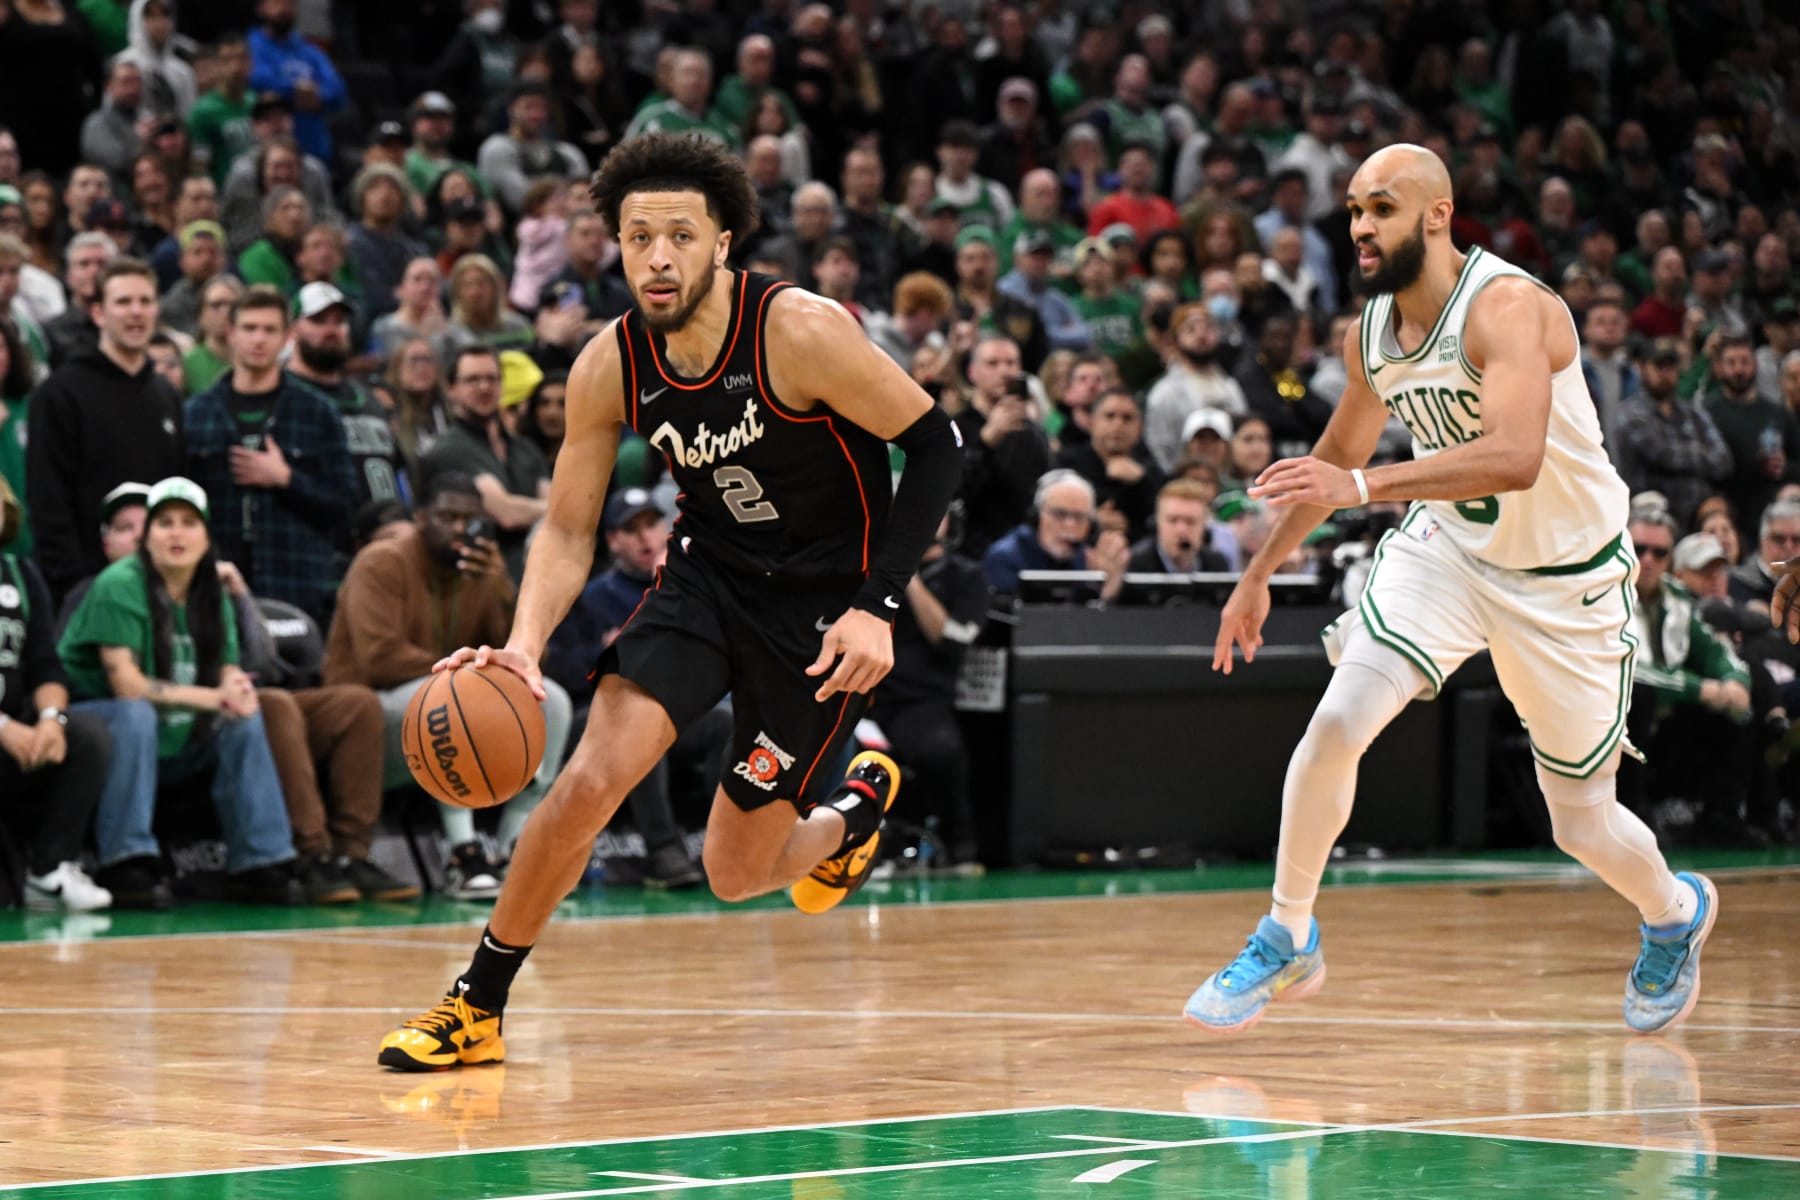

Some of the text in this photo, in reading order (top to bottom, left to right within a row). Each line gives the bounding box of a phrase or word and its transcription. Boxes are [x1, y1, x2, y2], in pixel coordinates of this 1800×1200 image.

[1438, 335, 1457, 351] VISTA
[1438, 350, 1457, 364] PRINT
[723, 373, 753, 390] UWM
[650, 398, 764, 468] Detroit
[713, 465, 780, 523] 2
[427, 703, 471, 797] Wilson
